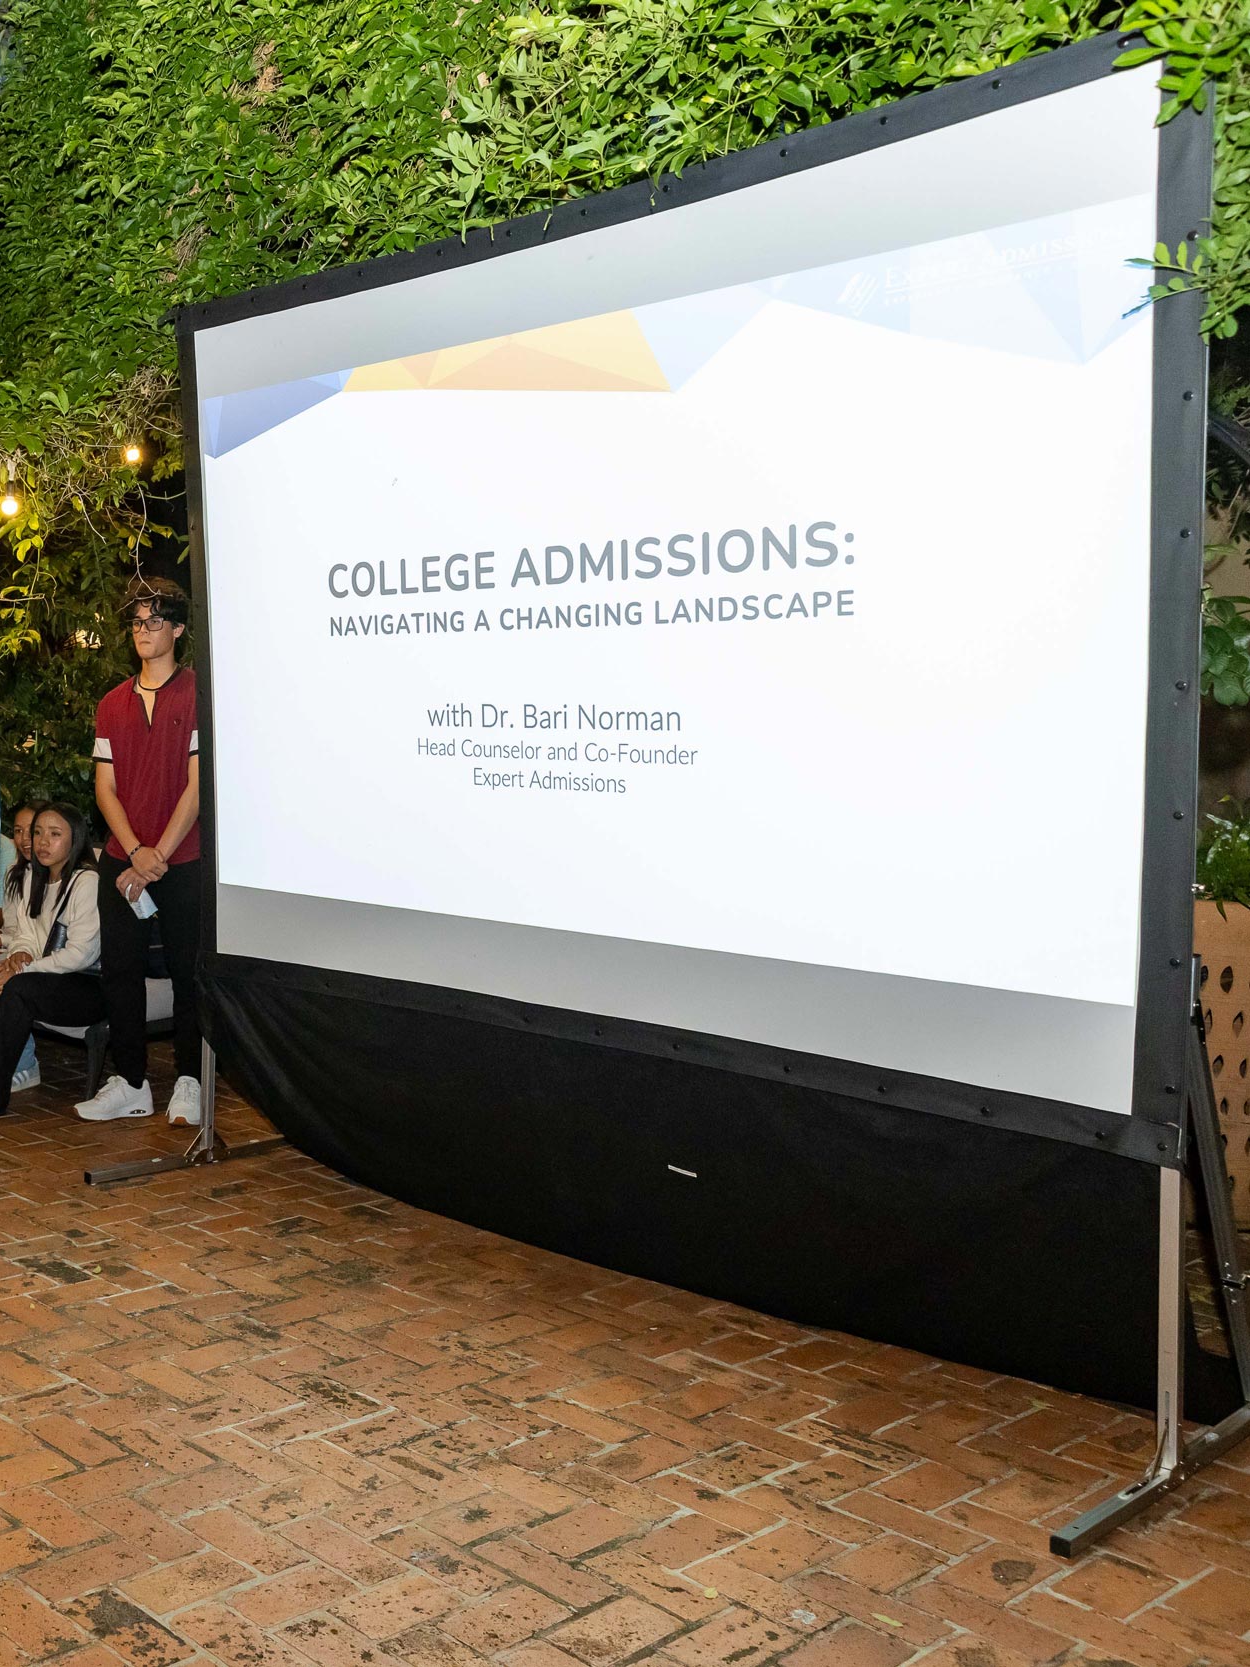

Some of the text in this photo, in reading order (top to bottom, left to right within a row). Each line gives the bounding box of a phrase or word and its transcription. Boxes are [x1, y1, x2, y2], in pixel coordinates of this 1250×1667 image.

[327, 520, 855, 598] COLLEGE ADMISSIONS:
[329, 589, 855, 637] NAVIGATING A CHANGING LANDSCAPE
[426, 702, 681, 732] with Dr. Bari Norman
[417, 737, 699, 766] Head Counselor and Co-Founder
[473, 767, 627, 794] Expert Admissions
